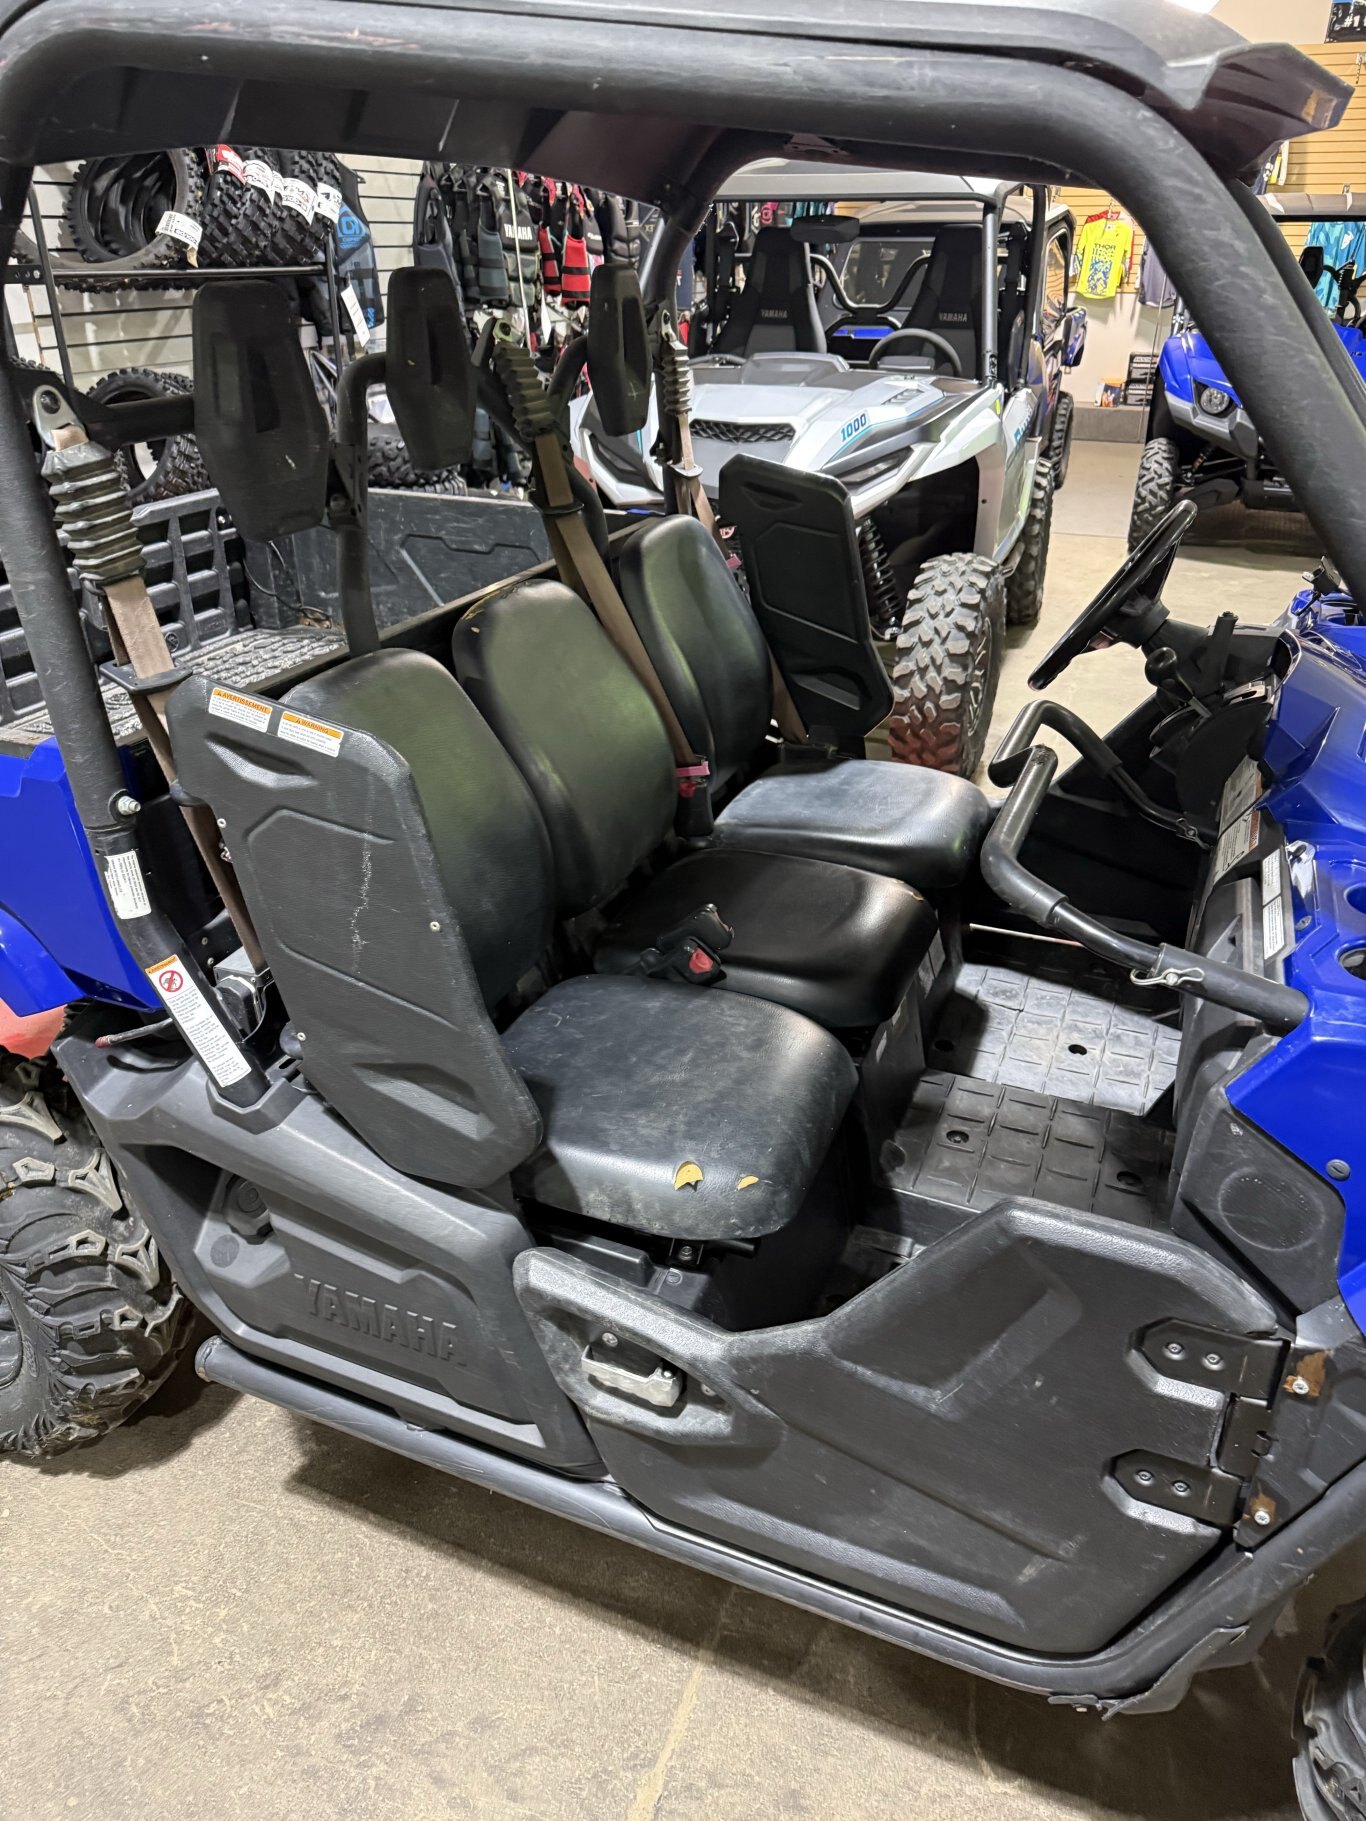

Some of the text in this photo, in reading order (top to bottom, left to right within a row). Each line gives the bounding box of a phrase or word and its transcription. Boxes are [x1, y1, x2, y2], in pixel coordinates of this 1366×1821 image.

[503, 223, 533, 240] YAAHA
[840, 413, 867, 443] 1000
[300, 718, 329, 734] WARNING
[294, 1273, 467, 1367] YAMAHA
